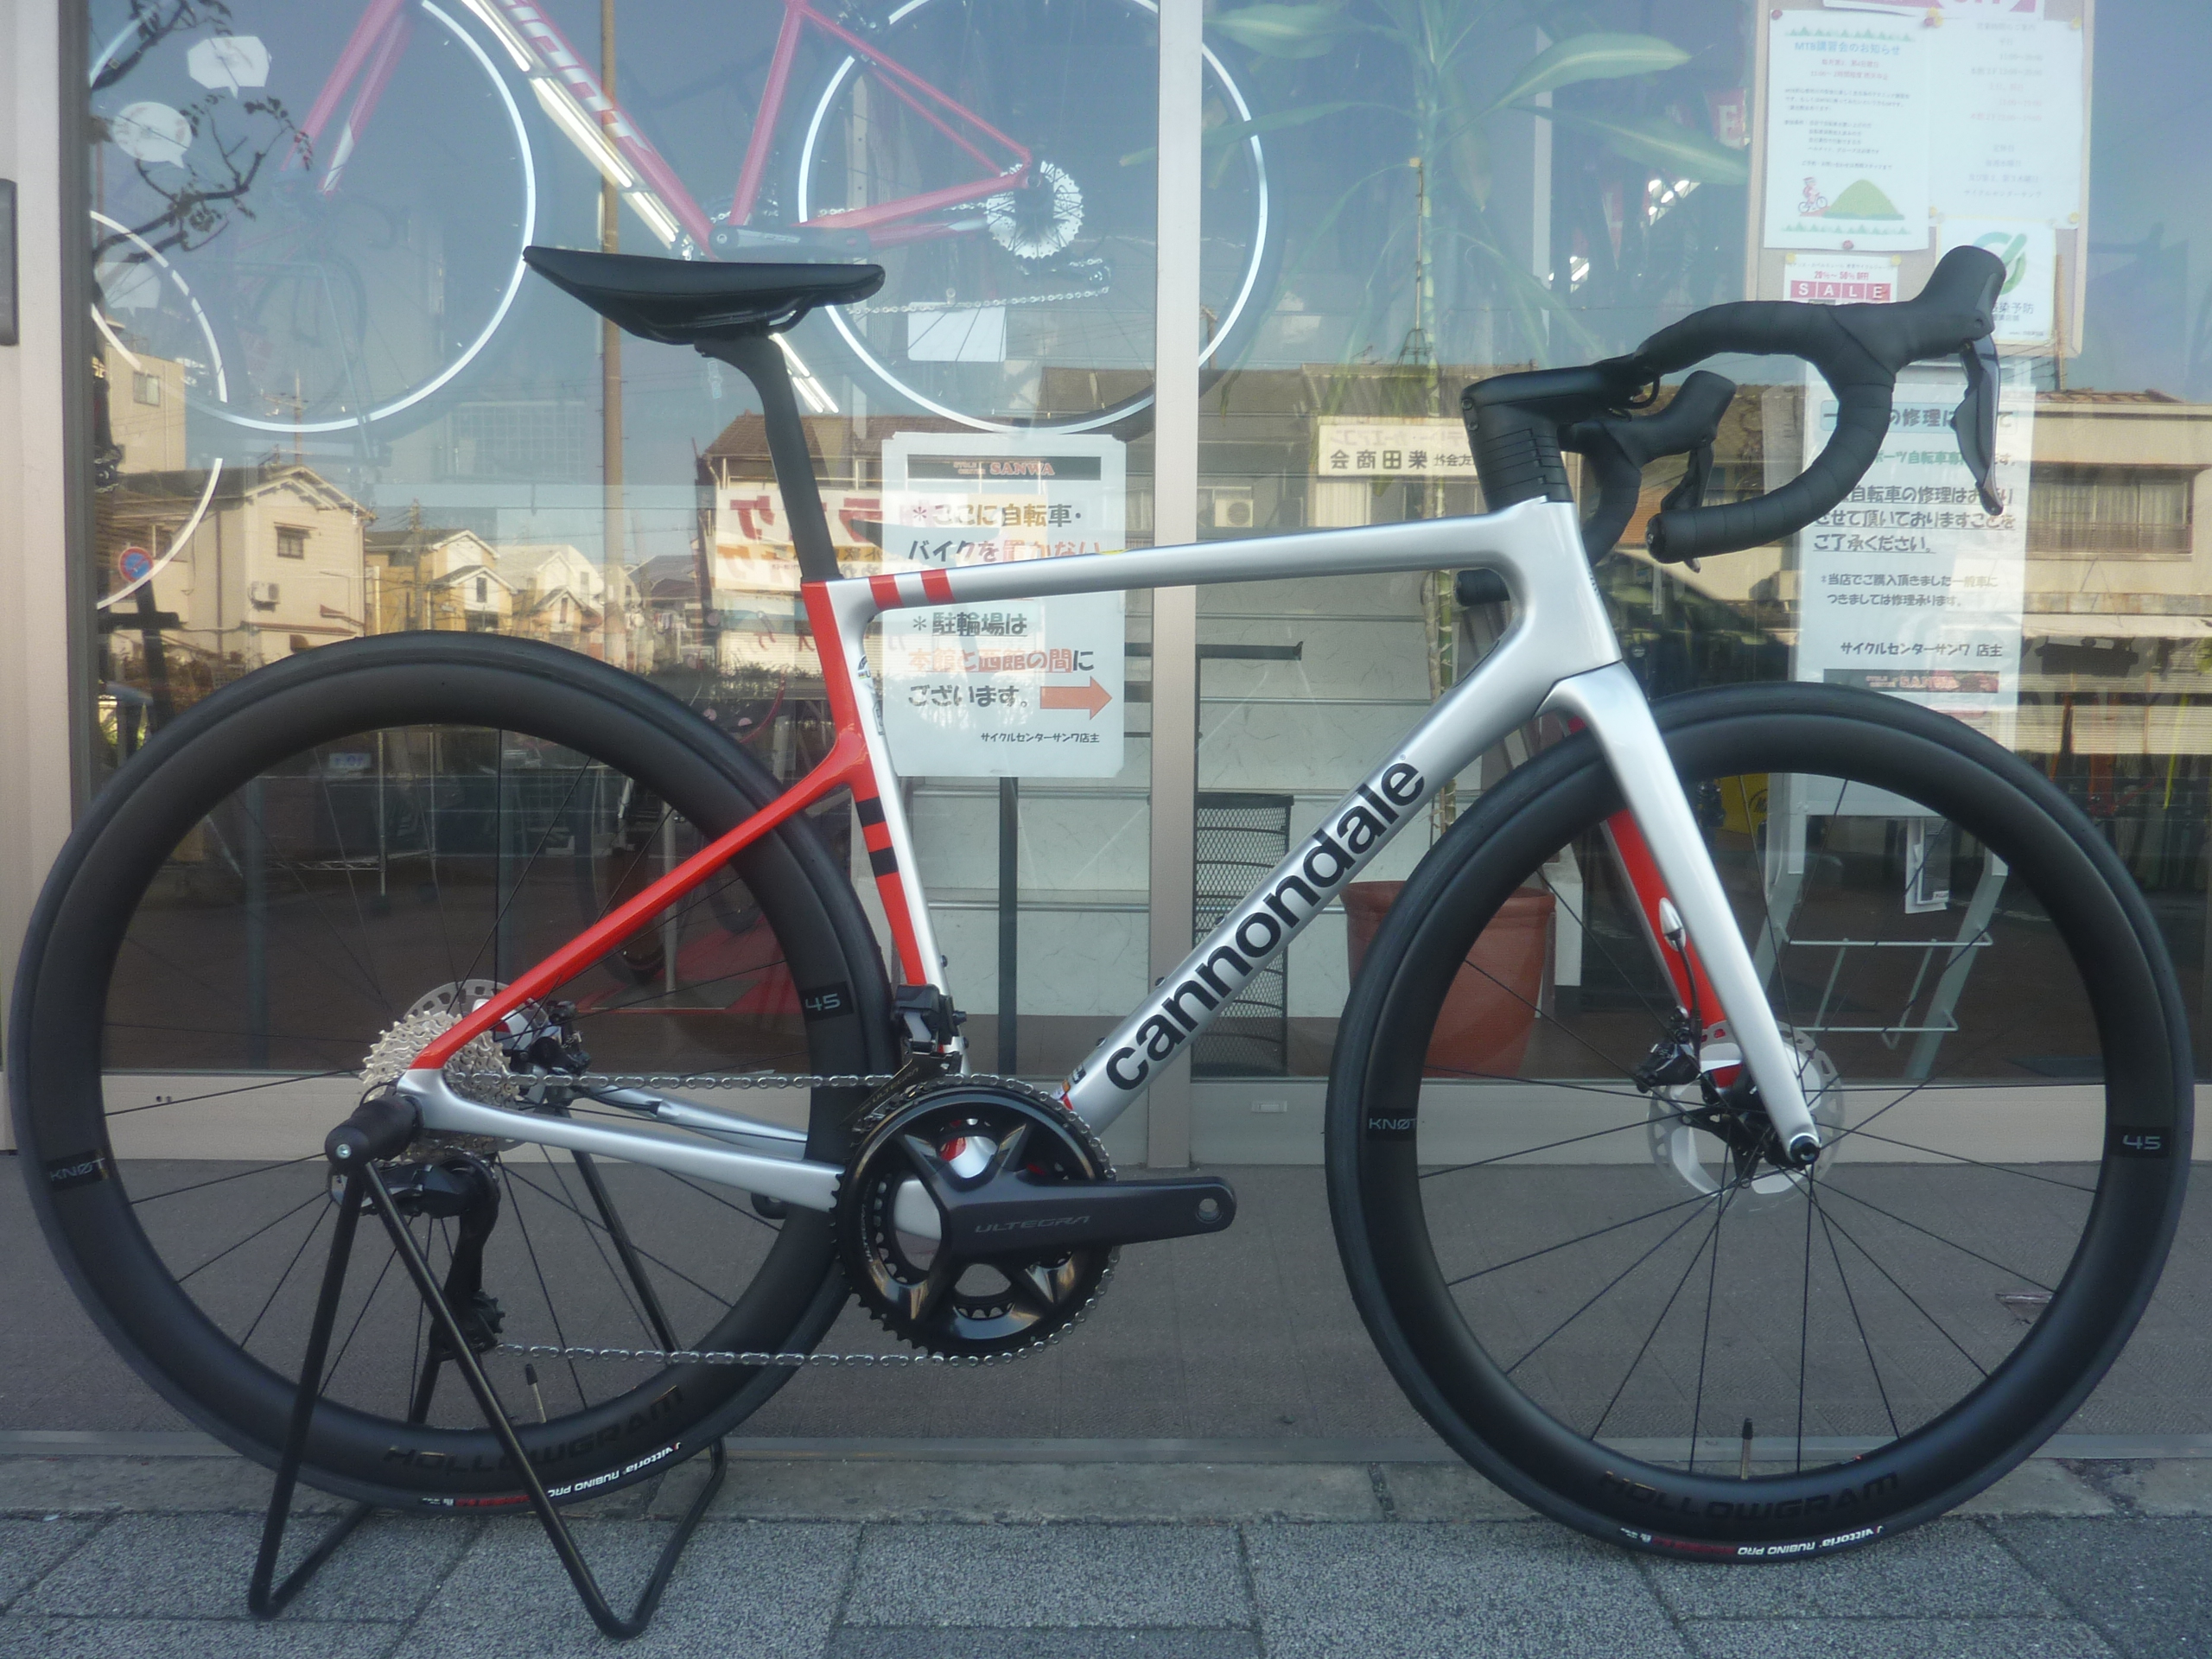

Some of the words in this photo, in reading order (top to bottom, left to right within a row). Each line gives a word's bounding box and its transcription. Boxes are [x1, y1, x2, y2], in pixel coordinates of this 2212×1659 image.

[1795, 41, 1901, 55] MTB講習会のお知らせ
[1798, 283, 1883, 299] SALE
[989, 462, 1055, 475] SANWA
[1814, 534, 1932, 553] ご了承ください。
[1827, 594, 1961, 607] つきましては修理承ります。
[1840, 642, 1970, 658] サイクルセンターサンワ
[1975, 643, 2003, 658] 店主
[908, 649, 1095, 672] 本館と西館の間に
[908, 685, 1028, 708] ございます。
[980, 731, 1100, 744] サイクルセンターサンワ店主
[1106, 762, 1426, 1091] cannondale
[804, 993, 842, 1011] 45
[2122, 1135, 2162, 1150] 45
[974, 1215, 1092, 1234] ULTEGRA
[1737, 1545, 1765, 1556] PRO
[1767, 1541, 1816, 1555] RUBINO
